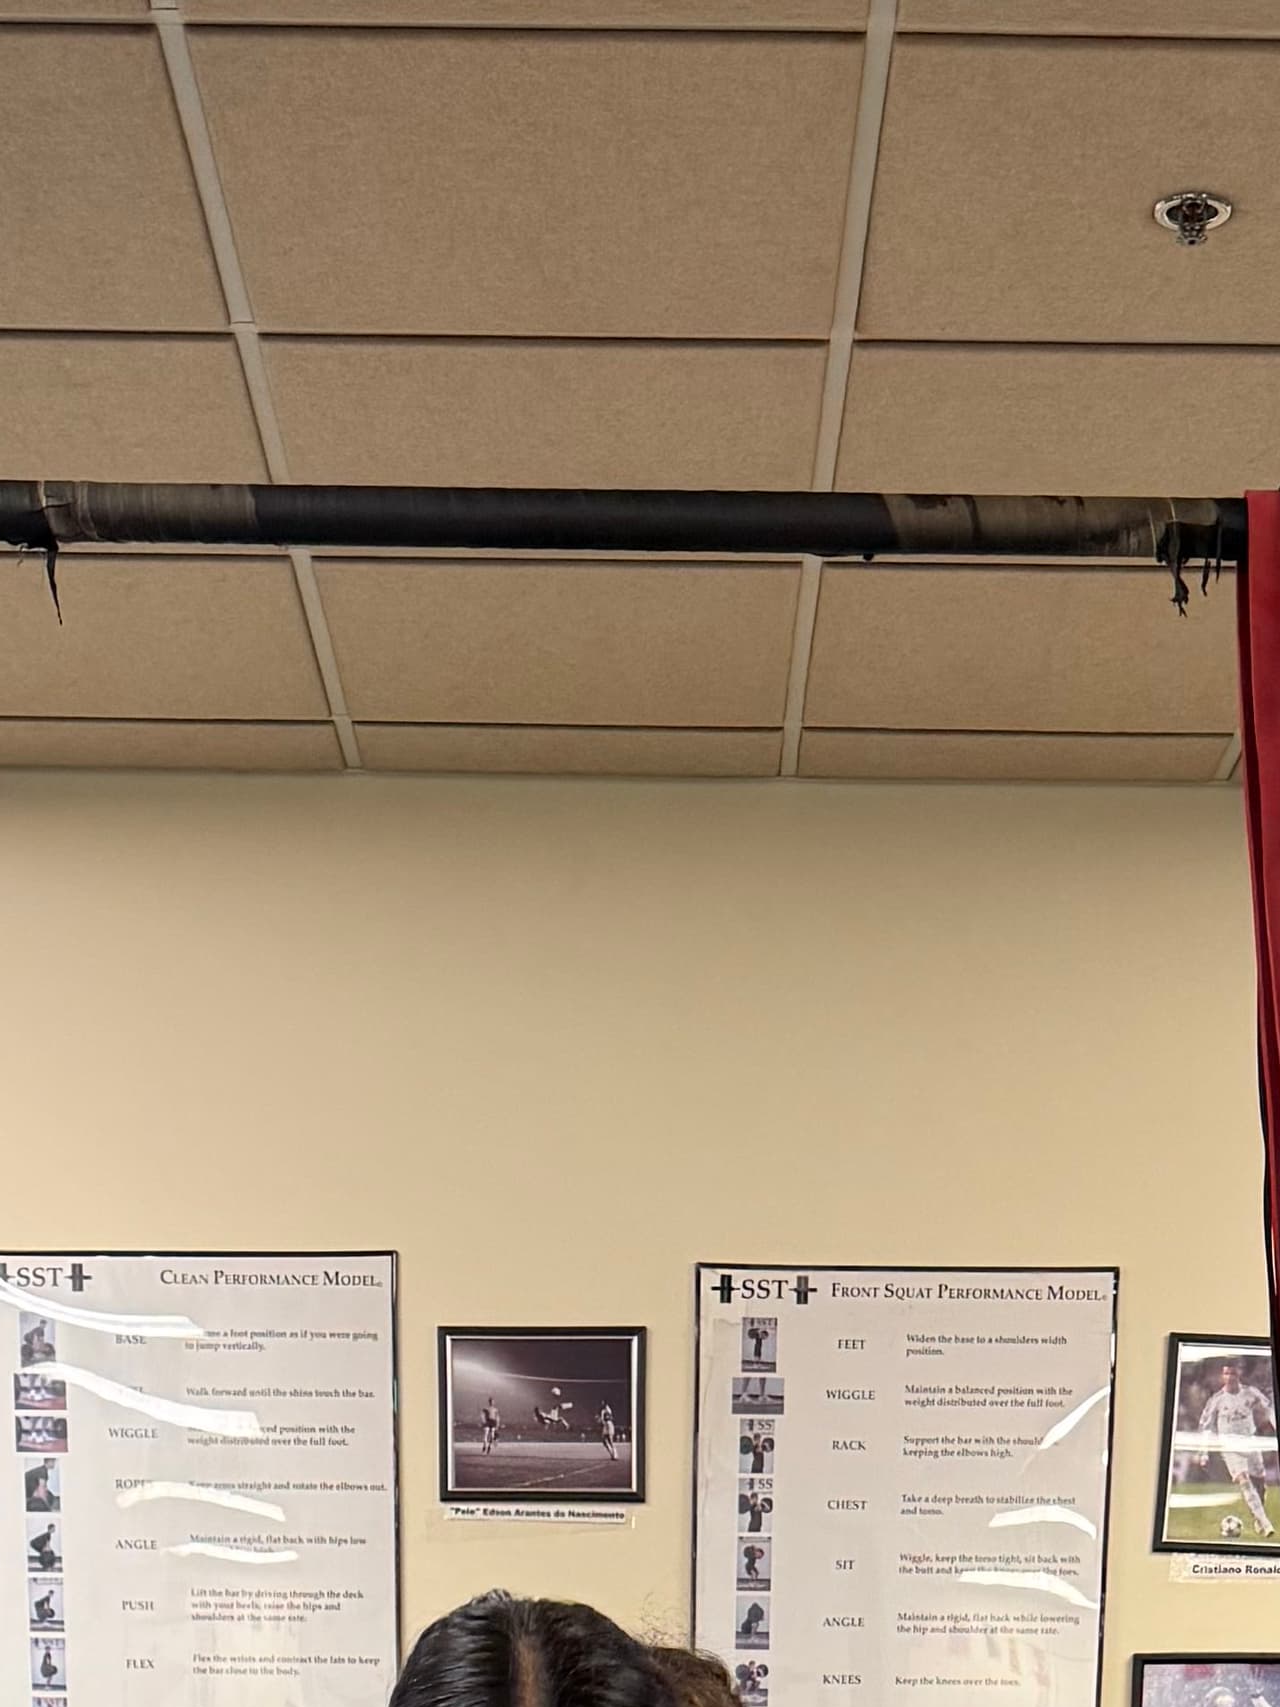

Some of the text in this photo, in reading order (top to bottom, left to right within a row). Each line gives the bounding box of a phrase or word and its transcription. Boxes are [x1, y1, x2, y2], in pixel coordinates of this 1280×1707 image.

[17, 1267, 63, 1289] SST
[160, 1269, 375, 1287] CLEAN PERFORMANCE MODEL
[741, 1279, 789, 1299] SST
[832, 1282, 1101, 1301] FRONT SQUAT PERFORMANCE MODEL
[115, 1334, 146, 1344] BASE
[838, 1339, 866, 1350] FEET
[826, 1389, 875, 1400] WIGGLE
[109, 1428, 158, 1439] WIGGLE
[832, 1440, 866, 1451] RACK
[827, 1499, 868, 1511] CHEST
[116, 1539, 157, 1550] ANGLE
[835, 1560, 855, 1570] SIT
[1192, 1562, 1242, 1574] Cristiano
[122, 1600, 154, 1610] PUSH
[823, 1616, 864, 1627] ANGLE
[126, 1659, 154, 1669] FLEX
[823, 1674, 861, 1685] KNEES
